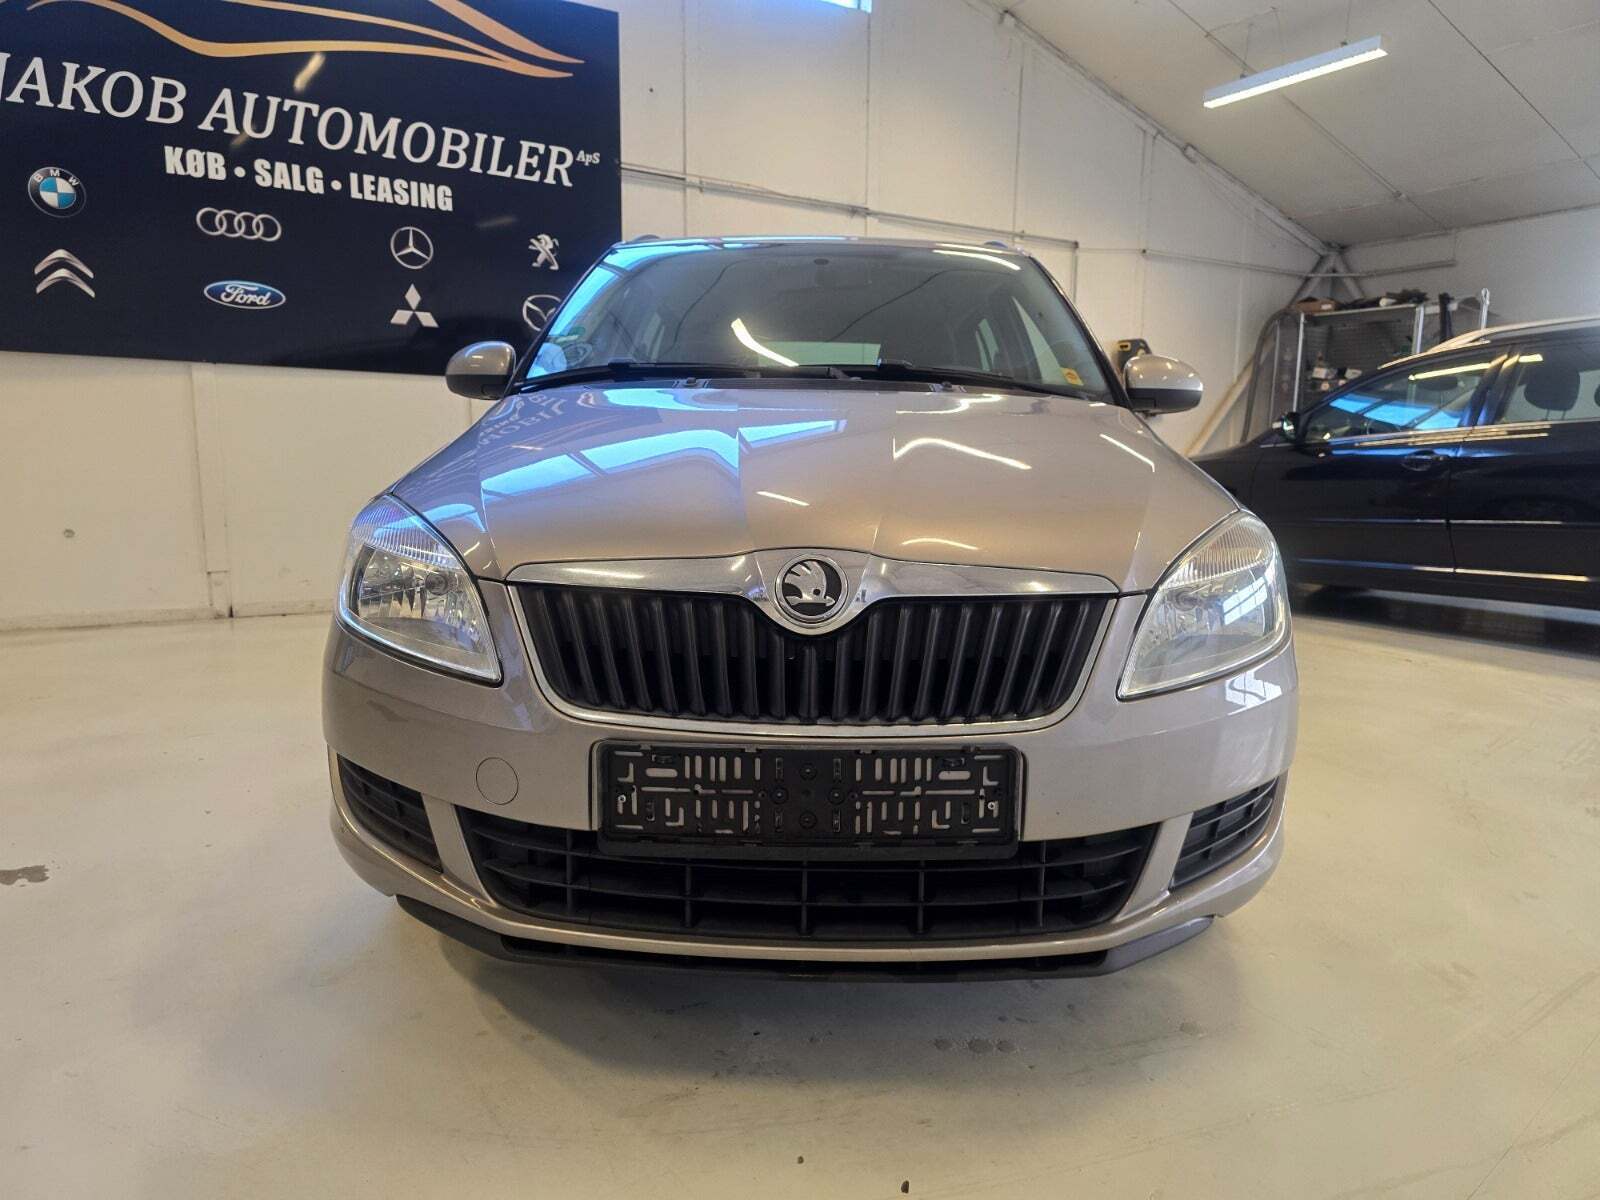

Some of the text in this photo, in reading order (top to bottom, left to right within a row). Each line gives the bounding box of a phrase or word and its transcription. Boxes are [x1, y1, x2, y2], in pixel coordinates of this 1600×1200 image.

[197, 87, 574, 187] AUTOMOBILER
[576, 149, 600, 165] ApS
[33, 168, 80, 187] BMW
[163, 145, 454, 212] KØB SALG LEASING
[220, 284, 272, 306] Ford
